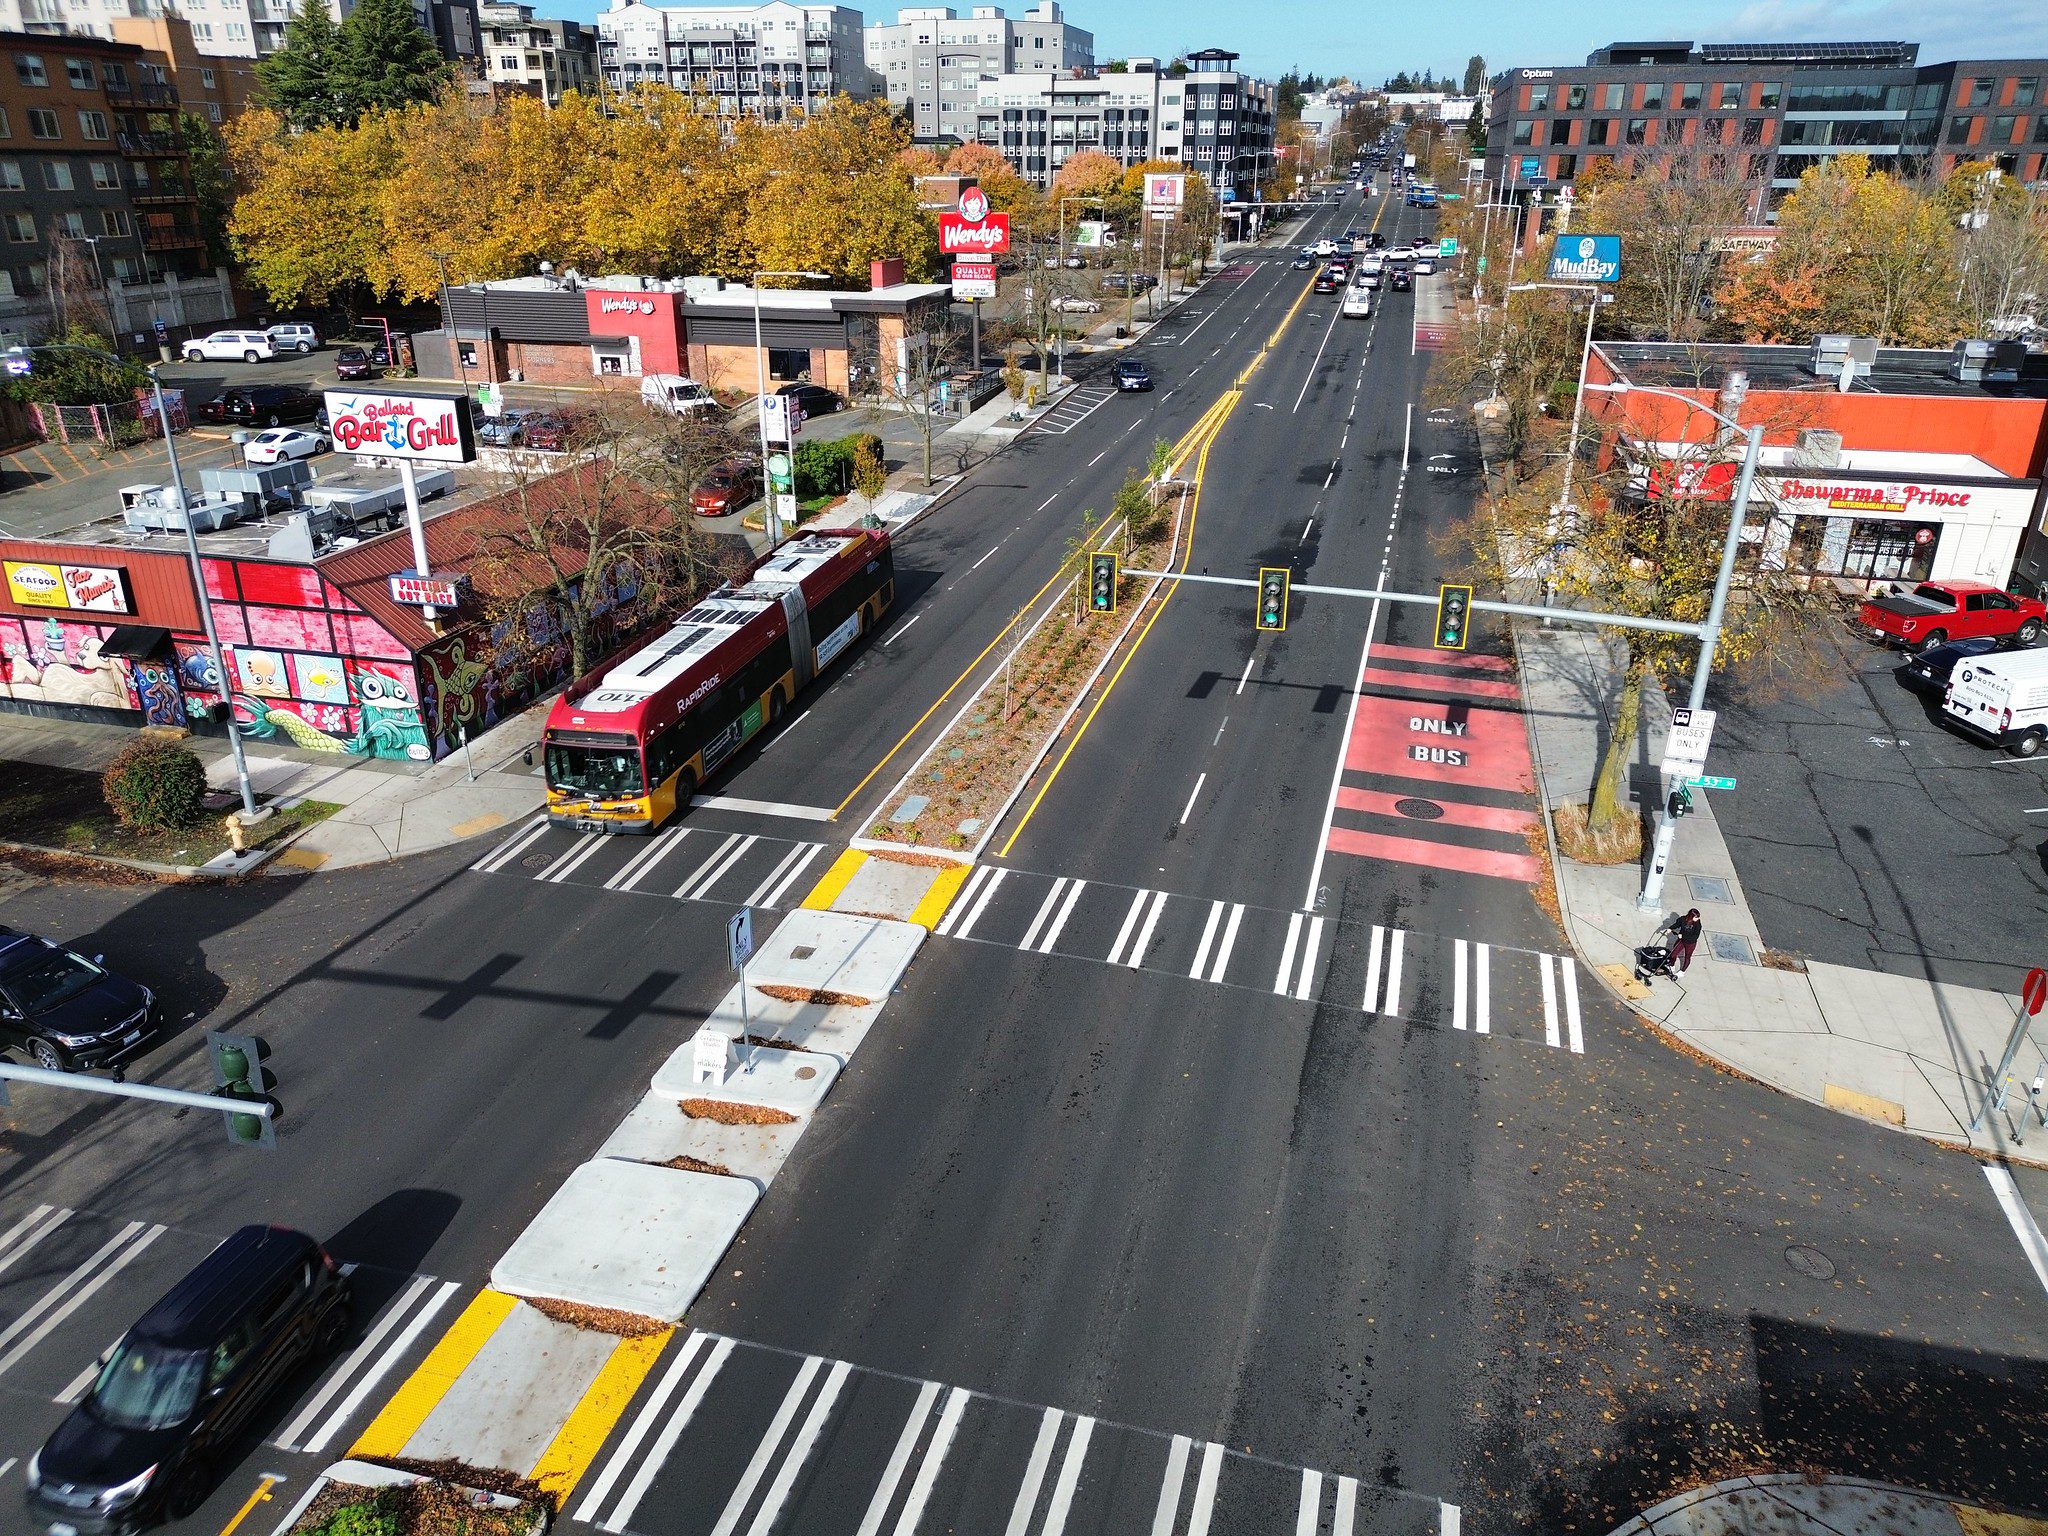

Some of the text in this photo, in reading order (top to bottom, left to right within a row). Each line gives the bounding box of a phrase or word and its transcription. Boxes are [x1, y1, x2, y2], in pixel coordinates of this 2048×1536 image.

[1522, 69, 1553, 79] Optum
[944, 221, 1004, 249] Wendy's
[1721, 240, 1771, 250] SAFEWAY
[955, 266, 992, 274] QUALITY
[1553, 258, 1617, 277] MudBay
[601, 296, 638, 315] Wendy's
[363, 398, 414, 421] Ballard
[333, 412, 458, 451] Bar Grill
[1779, 479, 1971, 507] Shawarma Prince
[1830, 501, 1905, 511] MEDITERRANEAN GRILL
[13, 575, 57, 586] SEAFOOD
[65, 568, 93, 588] Taco
[399, 578, 448, 593] PARKING
[75, 575, 116, 606] Mama's
[398, 591, 453, 604] OUT BACK
[1973, 675, 2006, 692] PROTECH
[1410, 717, 1467, 737] ONLY
[1676, 728, 1705, 738] BUSES
[1676, 739, 1700, 748] ONLY
[1413, 745, 1462, 766] BUS
